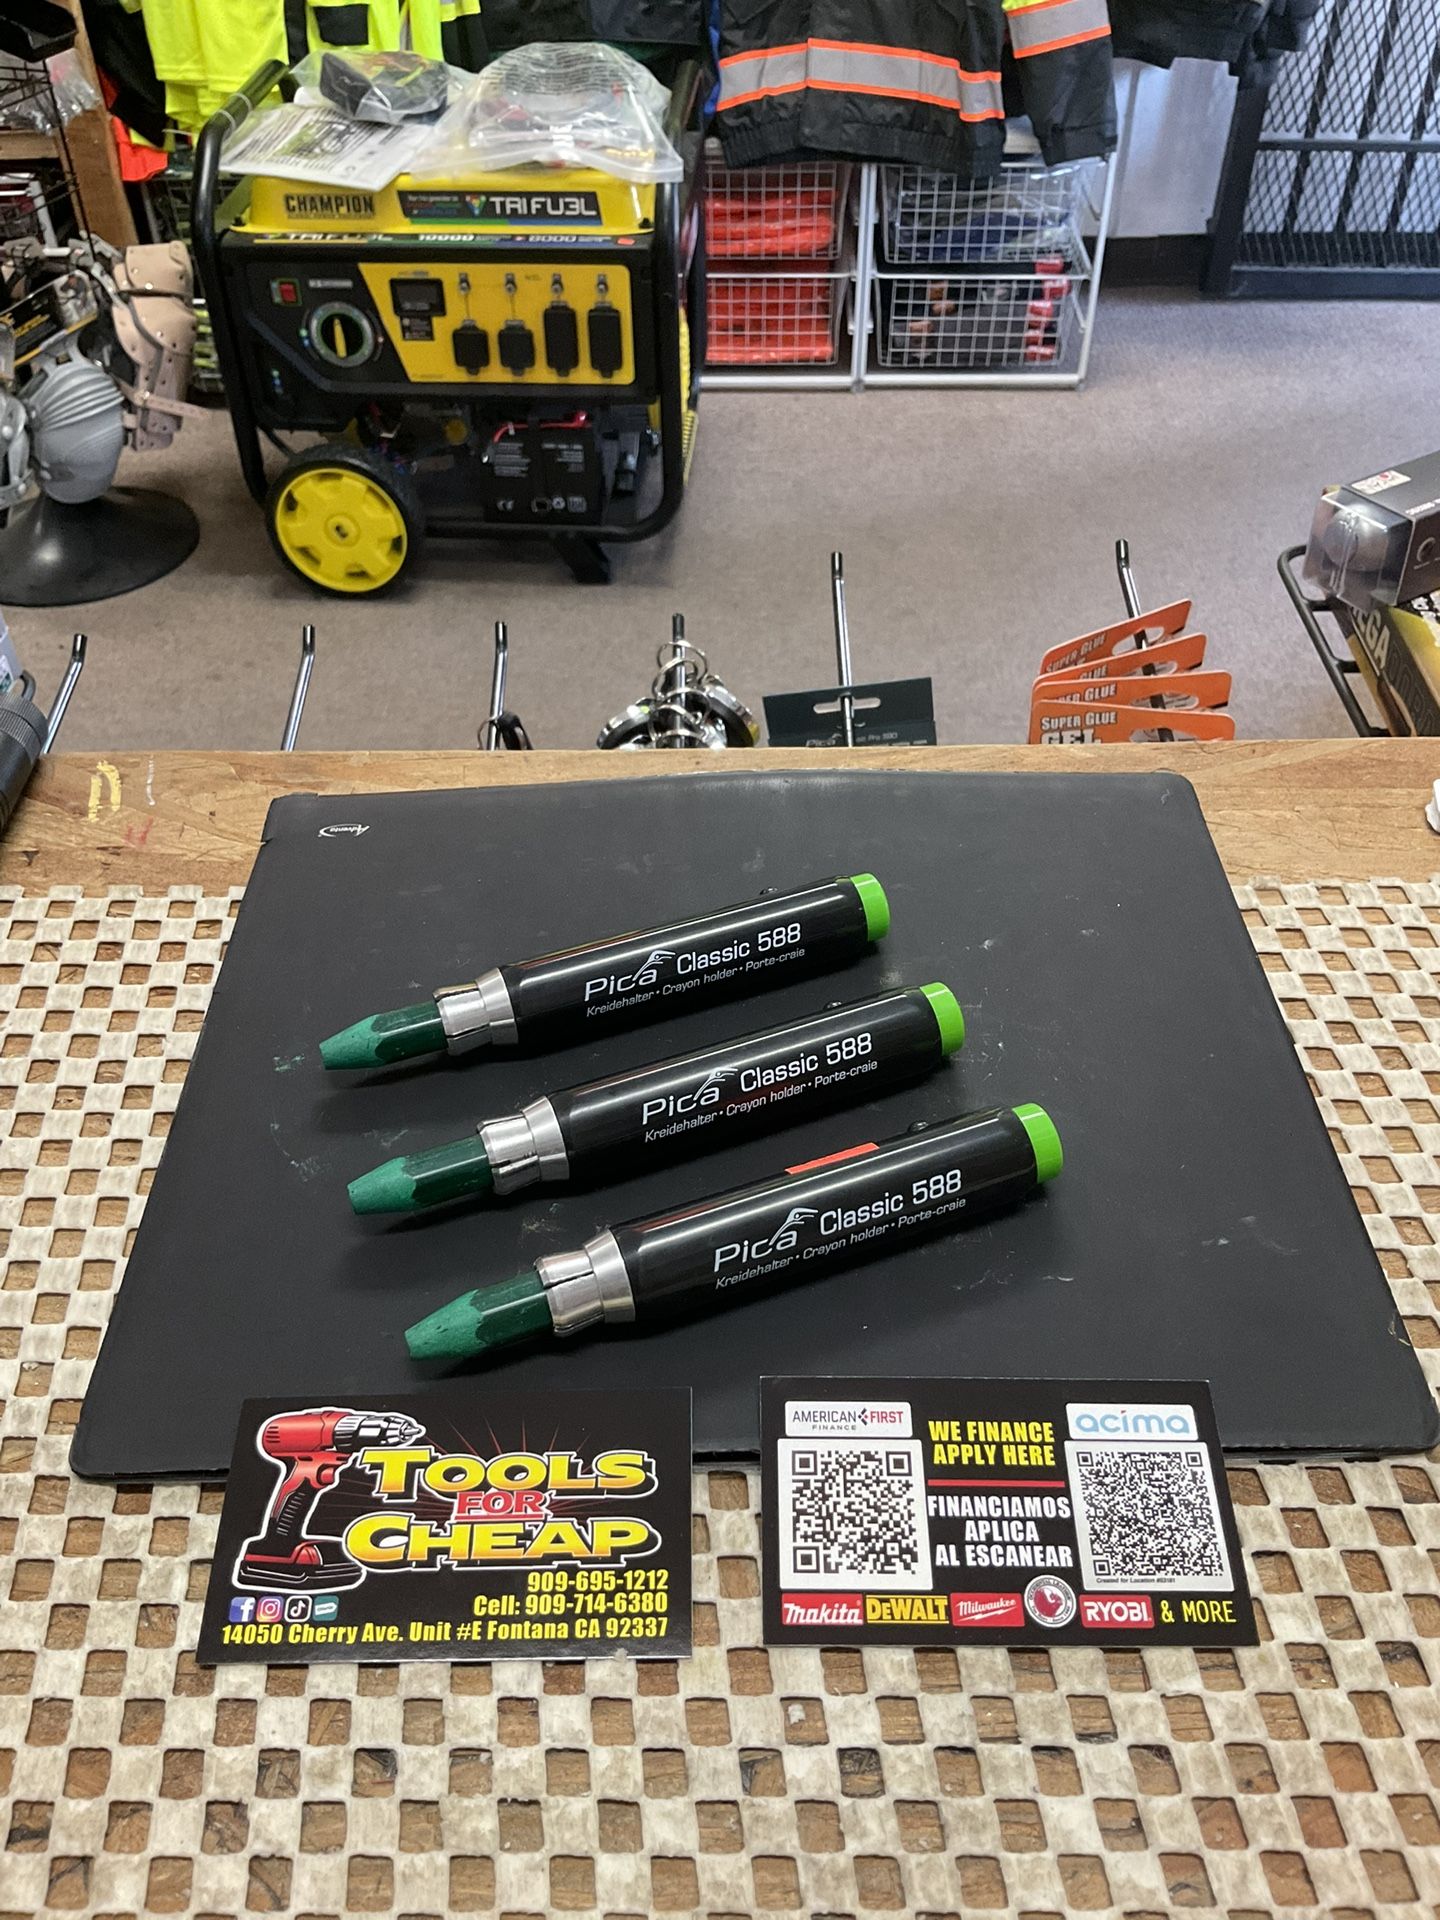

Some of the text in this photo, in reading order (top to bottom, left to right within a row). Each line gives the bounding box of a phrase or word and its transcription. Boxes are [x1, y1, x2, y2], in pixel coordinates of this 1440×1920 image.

[284, 194, 376, 214] CHAMPION
[1080, 634, 1106, 656] GLUE
[1084, 683, 1117, 702] GLUE
[1041, 711, 1117, 731] SUPER GLUE
[584, 922, 802, 1001] Pica Classic 588
[586, 947, 805, 1018] Kreidehalter Crayon holder Porte-craie
[642, 1032, 873, 1125] Pica Classic 588
[644, 1060, 878, 1143] Kreidehalter Crayon holder Porte-craie
[714, 1168, 962, 1273] Pica Classic 588
[715, 1198, 967, 1289] Kreidehalter Crayon holder Porte-craie
[792, 1410, 904, 1424] AMERICAN FIRST
[928, 1420, 1055, 1443] WE FINANCE
[933, 1444, 1056, 1466] APPLY HERE
[360, 1446, 652, 1497] TOOLS
[454, 1490, 547, 1519] FOR
[927, 1495, 1072, 1519] FINANCIAMOS
[346, 1511, 654, 1565] CHEAP
[965, 1520, 1040, 1542] APLICA
[935, 1544, 1074, 1567] AL ESCANEAR
[527, 1569, 669, 1592] 909-695-1212
[473, 1592, 668, 1617] Cell: 909-714-6380
[958, 1597, 1017, 1616] Milwaukee
[1160, 1599, 1175, 1623] &
[1182, 1599, 1237, 1623] MORE
[222, 1616, 669, 1645] 14050 Cherry Ave. Unit #E Fontana CA 92337
